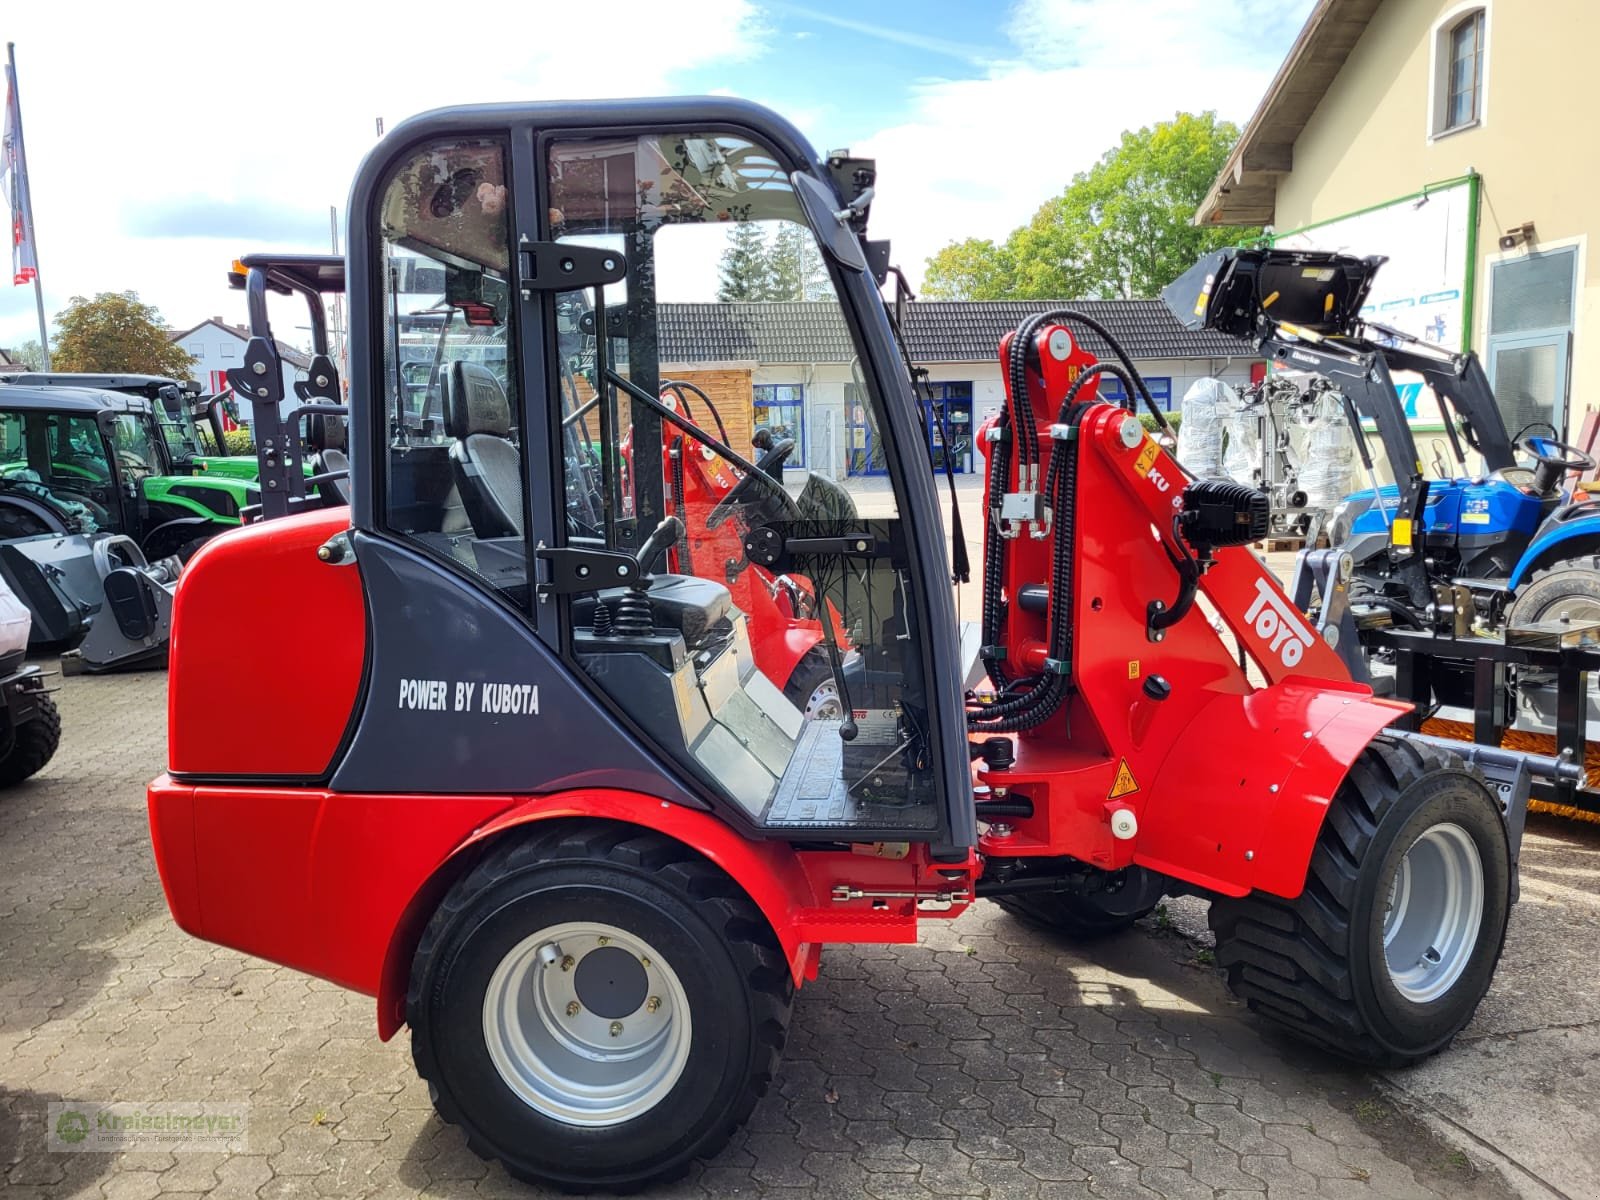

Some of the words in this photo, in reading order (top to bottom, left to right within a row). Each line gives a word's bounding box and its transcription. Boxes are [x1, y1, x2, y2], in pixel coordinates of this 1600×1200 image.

[1147, 467, 1170, 492] KU
[1244, 577, 1315, 667] TOYO
[399, 679, 447, 711] POWER
[454, 682, 475, 712] BY
[481, 683, 539, 715] KUBOTA
